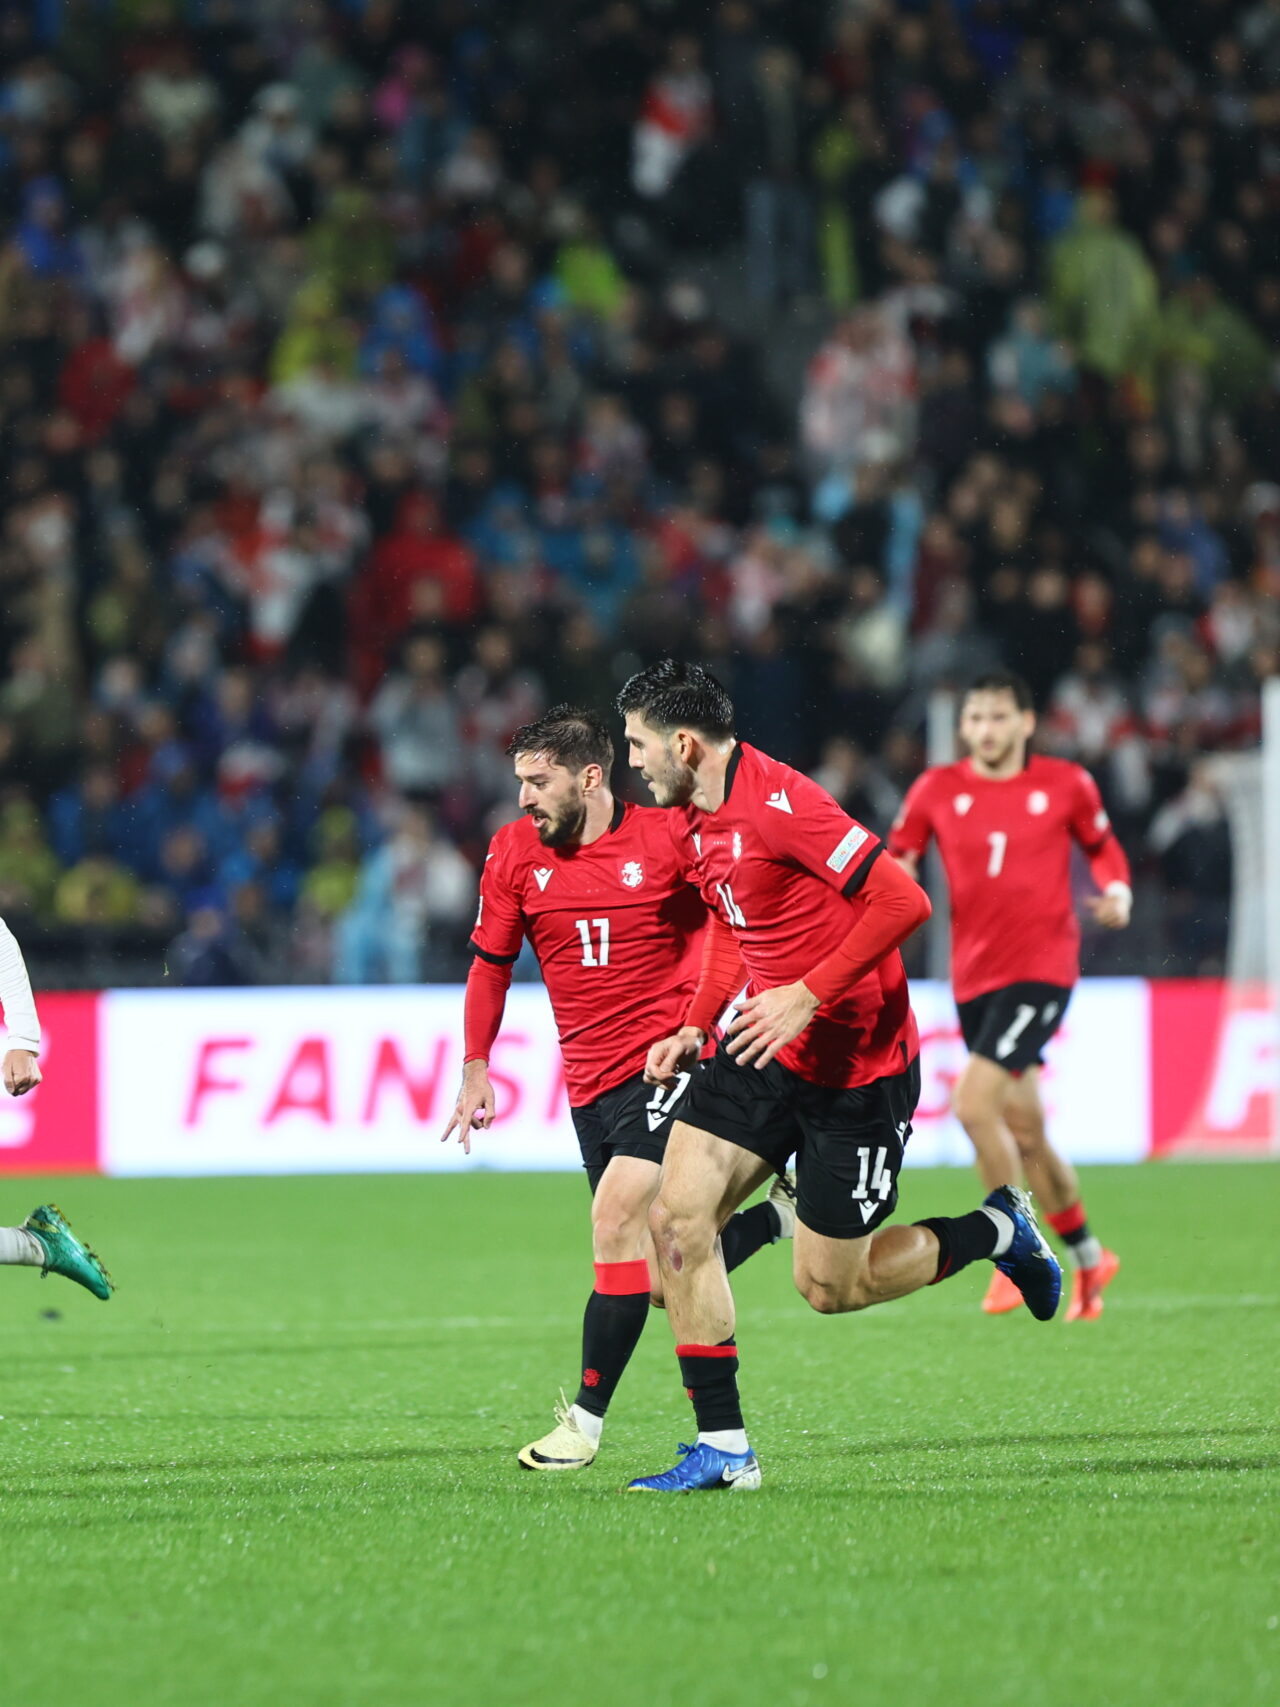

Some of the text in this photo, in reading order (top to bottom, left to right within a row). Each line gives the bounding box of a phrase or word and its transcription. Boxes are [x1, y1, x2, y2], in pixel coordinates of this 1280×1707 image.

[987, 831, 1008, 878] 7
[715, 883, 747, 928] 14
[575, 917, 610, 967] 17
[851, 1146, 892, 1200] 14
